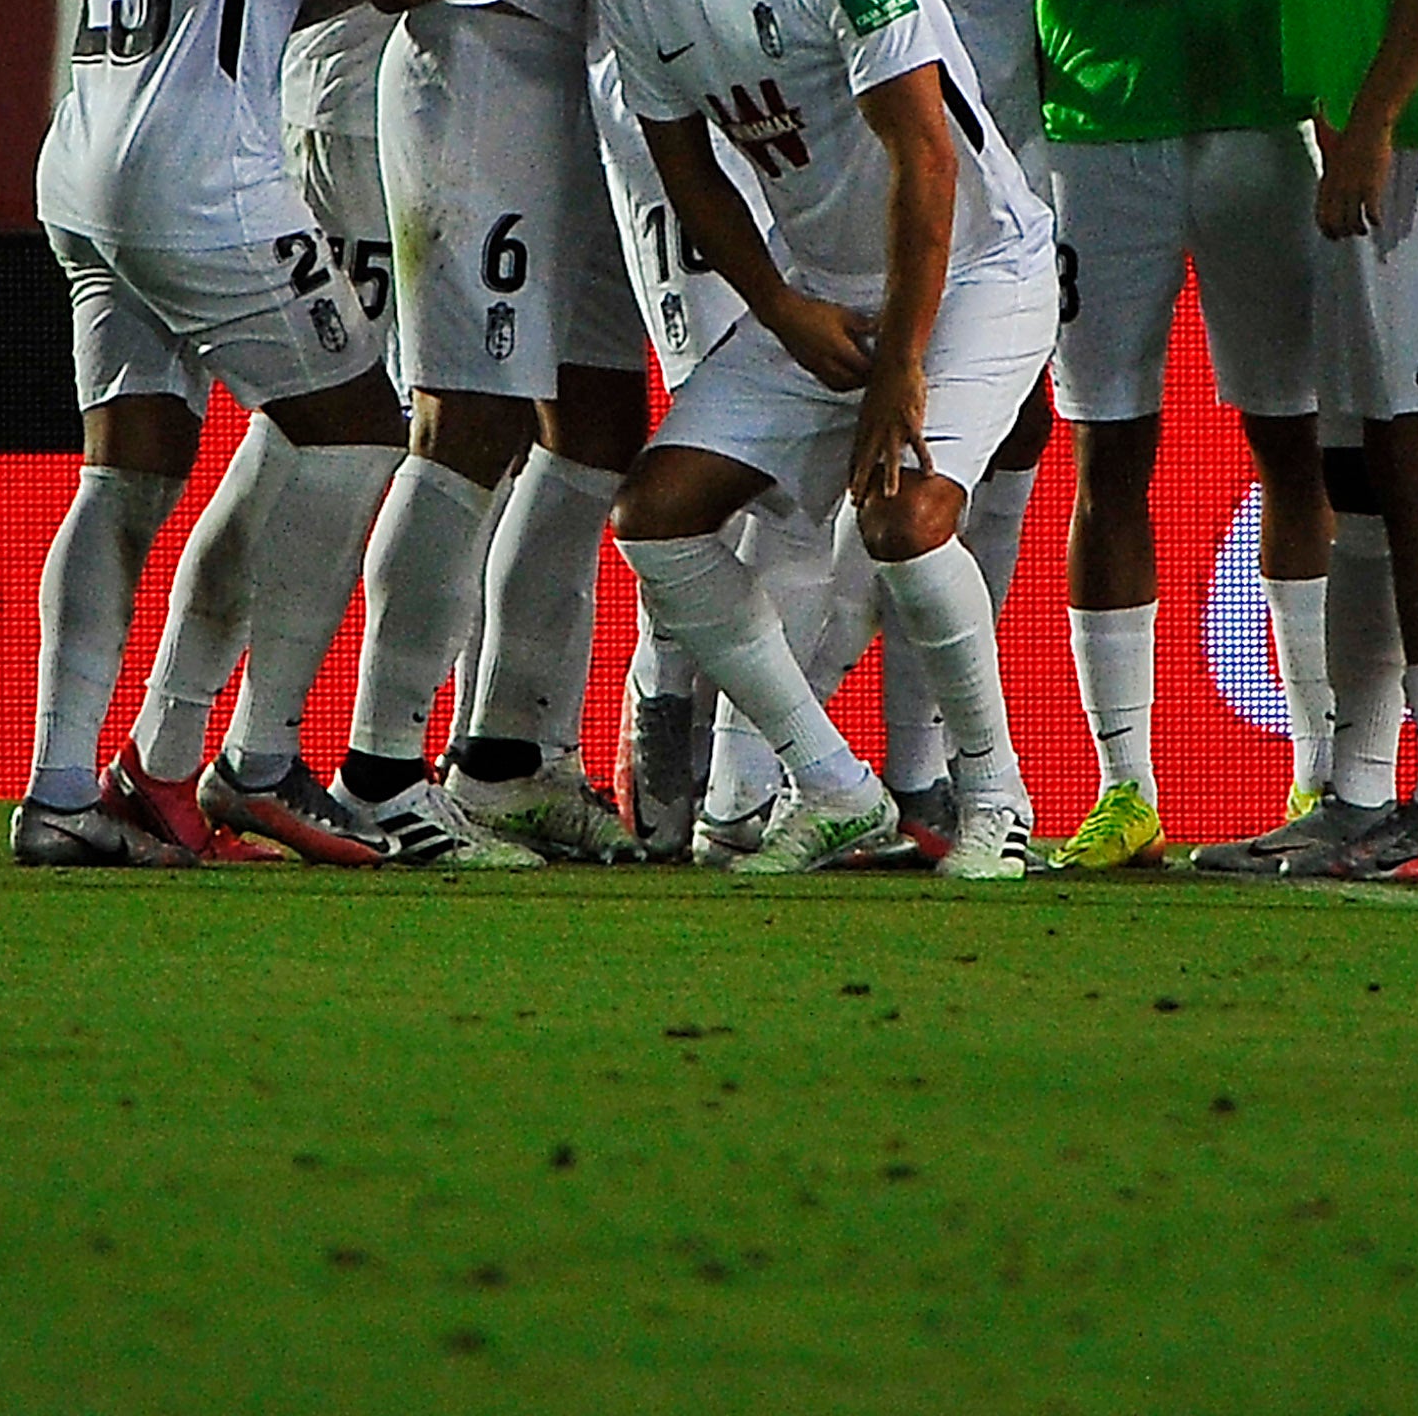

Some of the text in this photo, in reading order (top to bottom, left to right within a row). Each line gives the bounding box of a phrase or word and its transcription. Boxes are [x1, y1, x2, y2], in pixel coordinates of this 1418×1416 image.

[274, 229, 330, 297] 2
[482, 214, 527, 292] 6
[643, 205, 713, 283] 1
